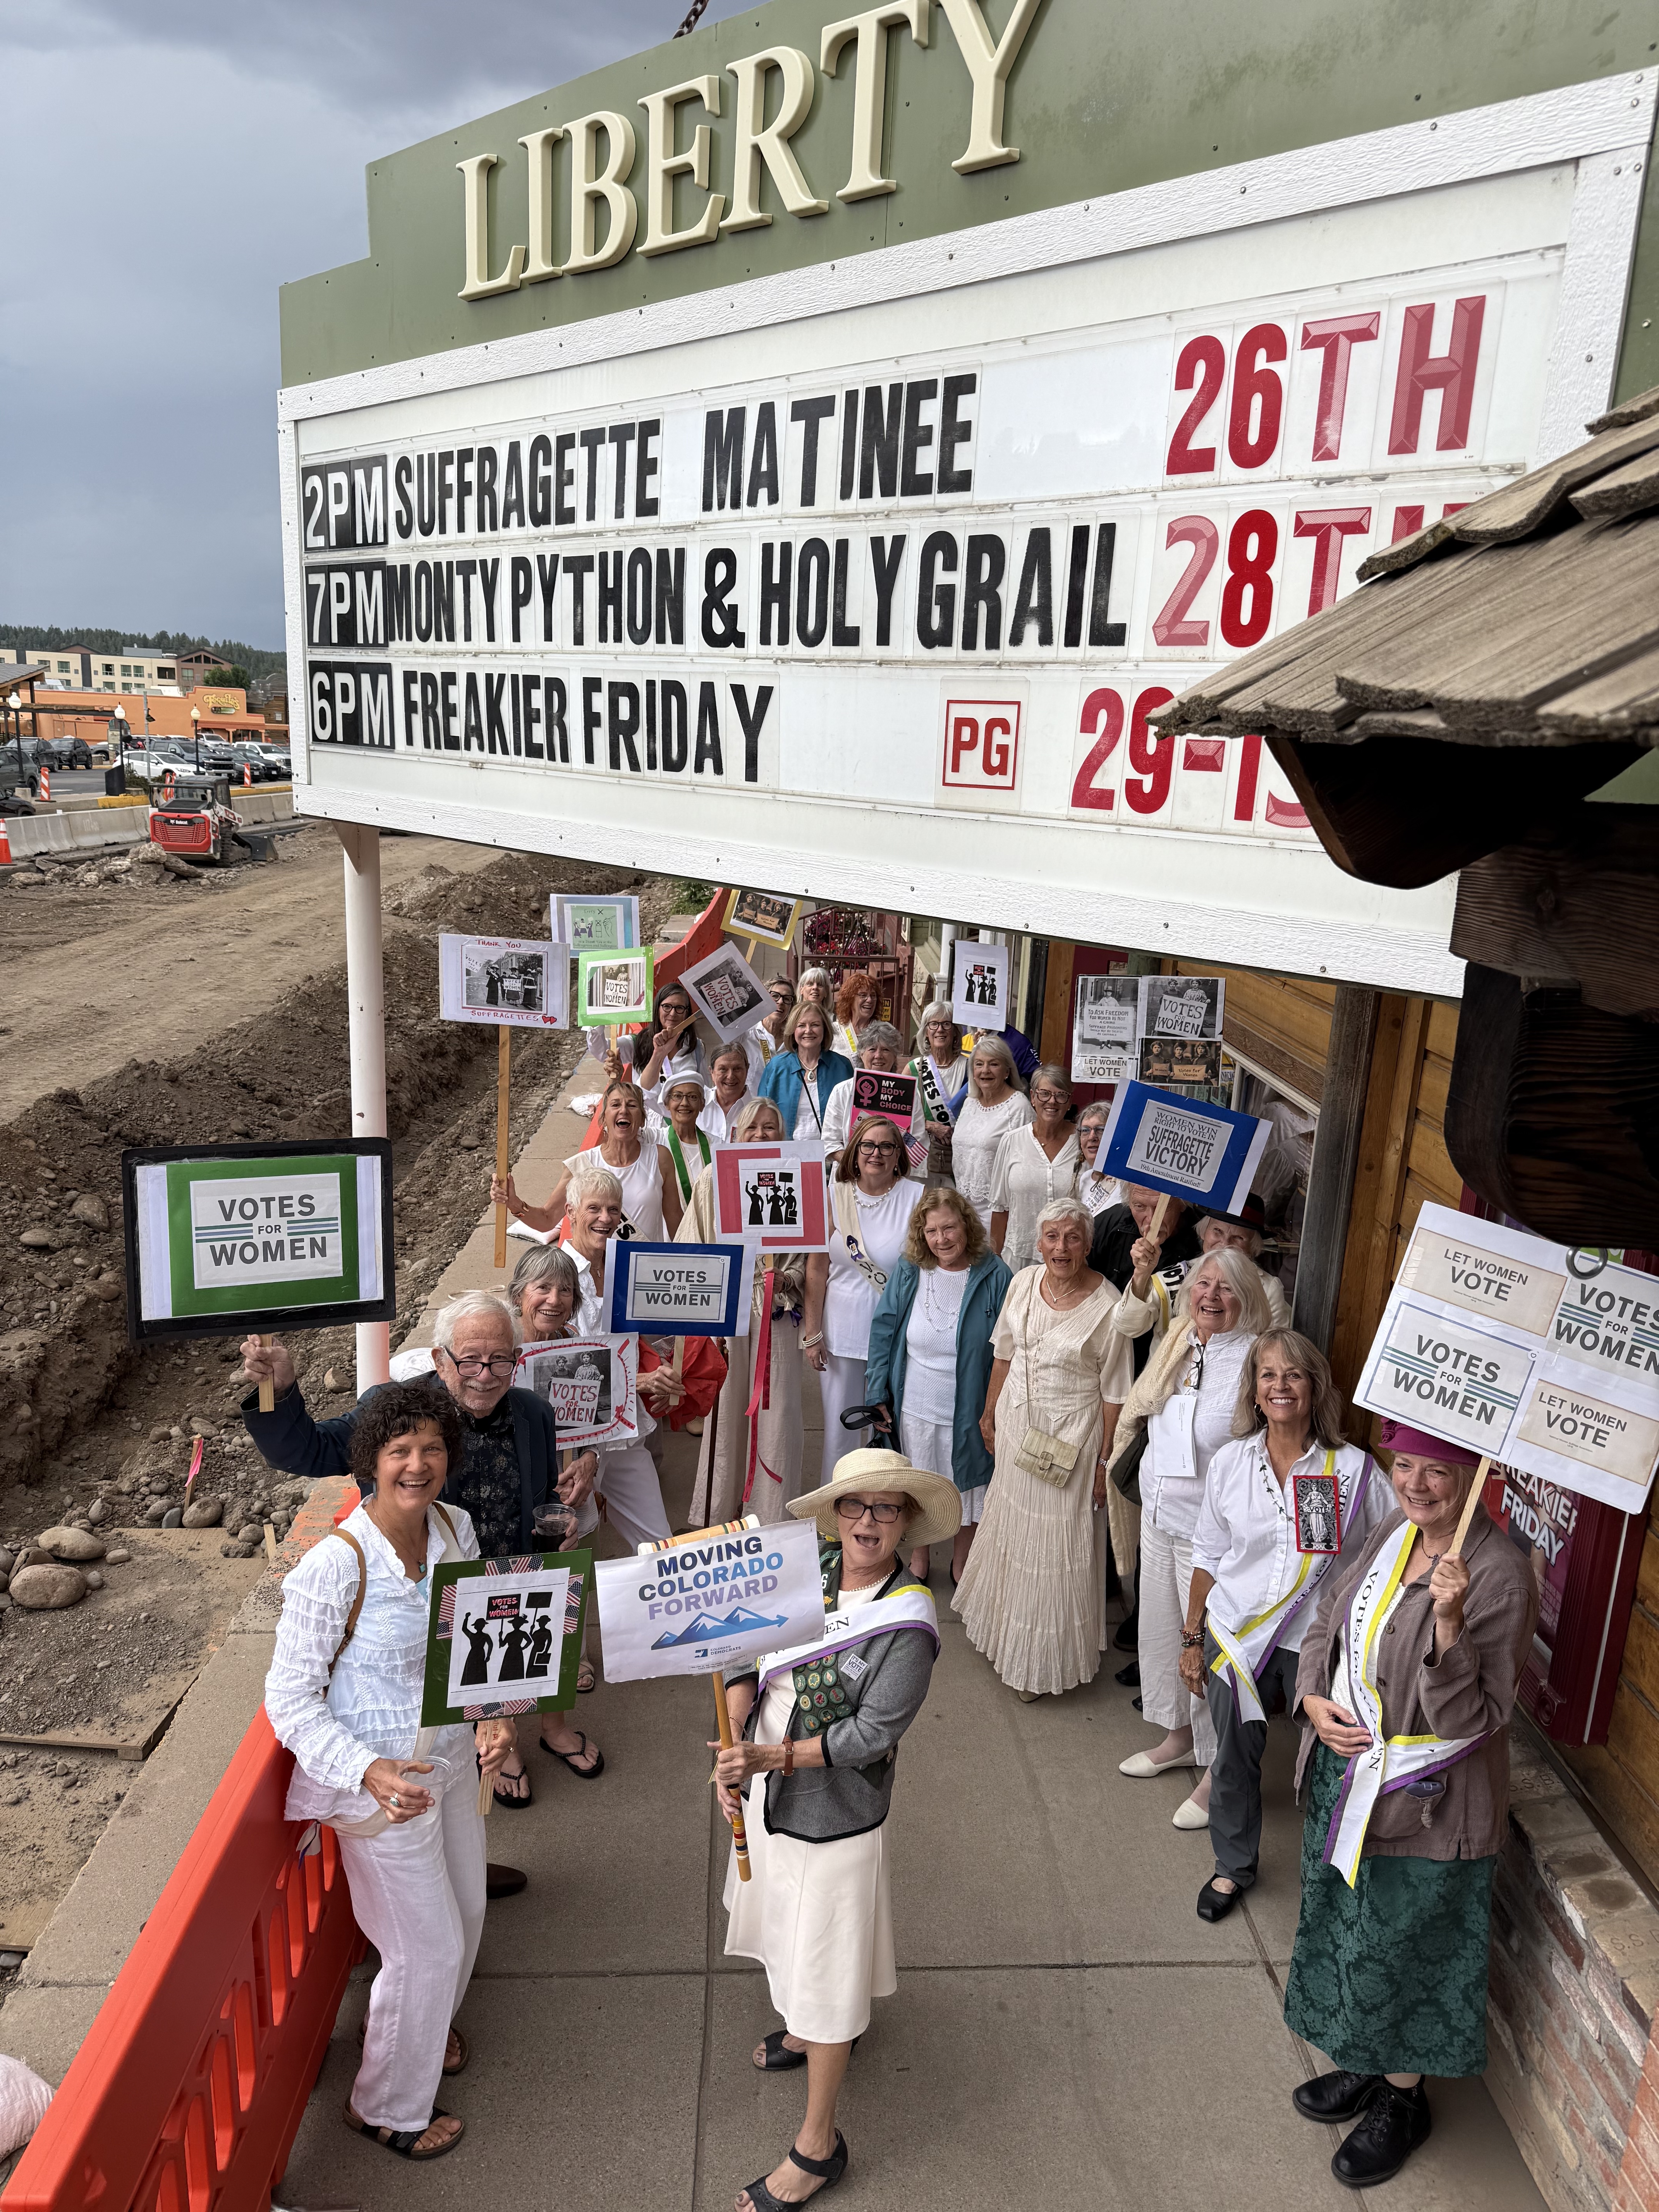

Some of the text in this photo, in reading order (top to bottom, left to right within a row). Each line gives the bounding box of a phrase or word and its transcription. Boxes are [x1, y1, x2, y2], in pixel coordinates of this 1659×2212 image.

[455, 0, 1042, 301] LIBERTY
[305, 295, 1486, 546] 2PM SUFFRAGETTE MATINEE 26TH
[307, 569, 386, 644] 7PM
[388, 558, 499, 644] MONTY
[512, 547, 685, 646] PYTHON
[701, 548, 745, 649] &
[760, 534, 906, 648] HOLY
[916, 523, 1127, 651] GRAIL
[313, 671, 390, 744] 6PM
[403, 670, 569, 763] FREAKIER
[583, 676, 774, 782] FRIDAY
[951, 716, 1011, 776] PG
[604, 994, 626, 1005] WOMEN
[606, 982, 628, 993] VOTES
[704, 982, 726, 1015] WOMEN
[718, 976, 738, 1010] VOTES
[471, 1010, 539, 1021] SUFFRAGETTES
[1163, 999, 1204, 1019] VOTES
[1157, 1017, 1200, 1035] WOMEN
[881, 1080, 896, 1088] MY
[1089, 1066, 1121, 1077] VOTE
[881, 1087, 906, 1096] BODY
[879, 1101, 912, 1111] CHOICE
[1154, 1118, 1176, 1129] RIGHT
[1177, 1123, 1186, 1132] TO
[1188, 1127, 1207, 1138] VOTE
[1157, 1111, 1195, 1128] WOMEN
[1198, 1123, 1218, 1135] WIN
[1149, 1125, 1214, 1160] SUFFRAGETTE
[1146, 1141, 1209, 1177] VICTORY
[1140, 1163, 1200, 1188] 19th Amendment Ratified!
[218, 1194, 316, 1221] VOTES
[258, 1224, 282, 1235] FOR
[210, 1236, 327, 1266] WOMEN
[653, 1269, 707, 1283] VOTES
[1444, 1248, 1529, 1286] LET WOMEN
[1451, 1266, 1512, 1302] VOTE
[646, 1292, 711, 1306] WOMEN
[1580, 1283, 1659, 1331] VOTES
[1604, 1320, 1629, 1335] FOR
[1417, 1334, 1501, 1383] VOTES
[1555, 1318, 1659, 1376] WOMEN
[1439, 1371, 1462, 1386] FOR
[552, 1383, 598, 1402] VOTES
[565, 1399, 580, 1408] FOR
[1393, 1367, 1497, 1425] WOMEN
[1538, 1391, 1627, 1432] LET WOMEN
[1546, 1410, 1610, 1448] VOTE
[1500, 1484, 1565, 1567] FRIDAY
[656, 1536, 763, 1578] MOVING
[1316, 1557, 1328, 1578] for
[639, 1552, 784, 1601] COLORADO
[492, 1597, 518, 1606] VOTES
[648, 1575, 778, 1620] FORWARD
[1354, 1570, 1379, 1643] VOTES
[489, 1608, 519, 1617] WOMEN
[711, 1646, 741, 1655] DEMOCRATS
[848, 1659, 863, 1673] VOTE
